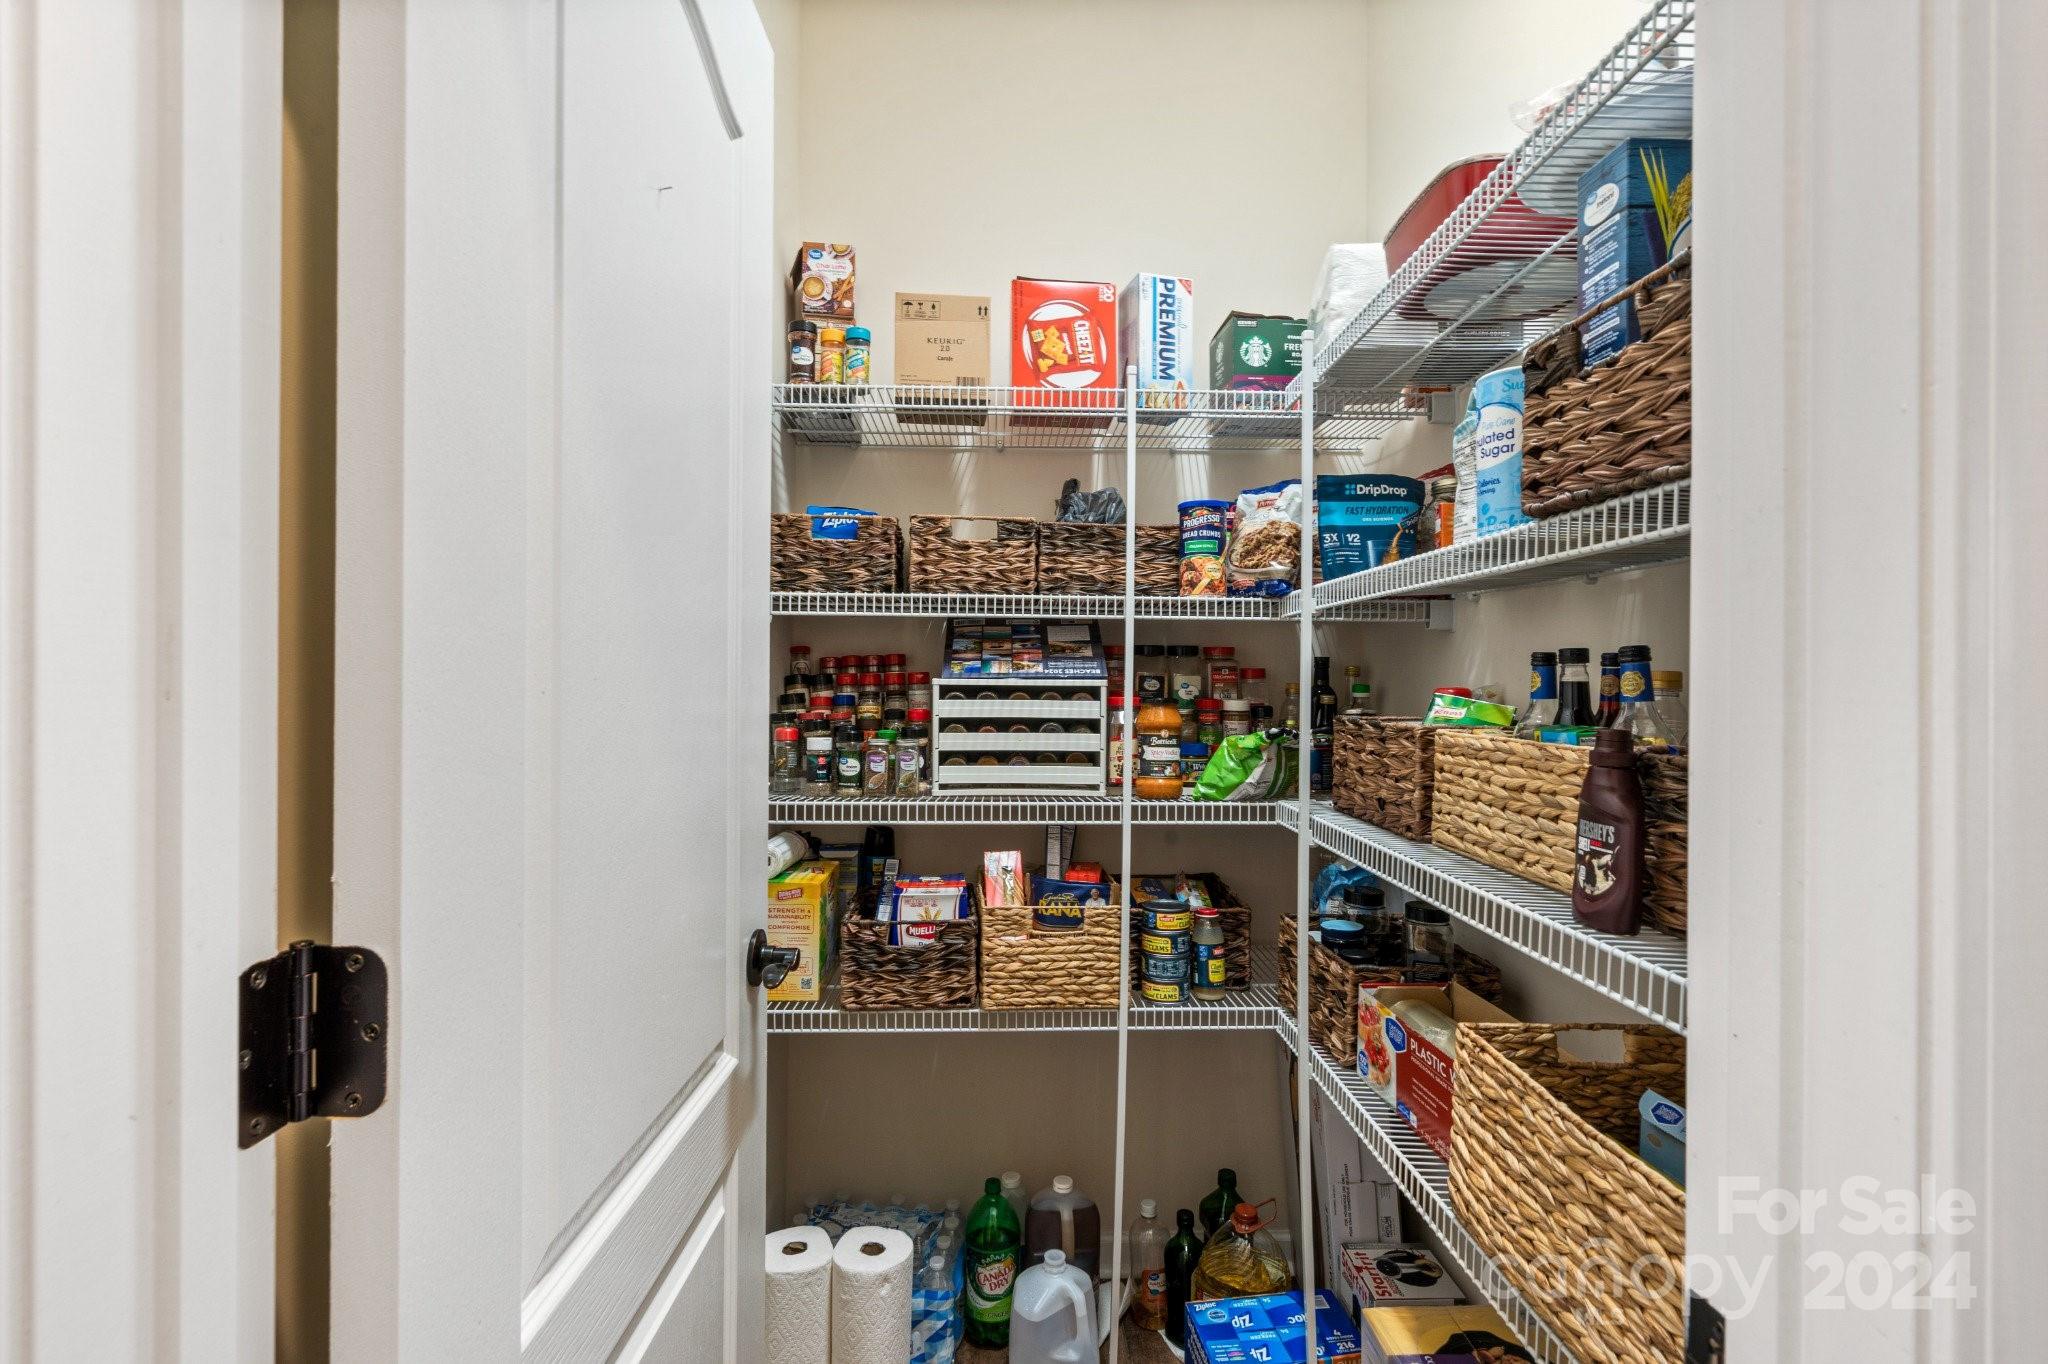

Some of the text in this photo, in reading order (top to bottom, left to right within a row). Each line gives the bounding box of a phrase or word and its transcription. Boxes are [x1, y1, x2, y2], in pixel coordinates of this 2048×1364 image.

[1158, 277, 1176, 381] PREMIUM
[926, 337, 965, 345] KEURIG
[1480, 443, 1516, 459] Sugar
[1356, 484, 1408, 497] DripDrop
[1345, 505, 1409, 515] FAST HYDRATION
[1183, 514, 1221, 528] PROGRESSO
[1182, 529, 1221, 540] BREAD CRUMBS
[1323, 533, 1338, 543] 3X
[909, 926, 936, 936] MUELL
[1410, 1038, 1447, 1078] PLASTIC
[977, 1263, 1014, 1286] CANADA
[1354, 1251, 1393, 1298] Starfrit
[989, 1277, 1009, 1291] DRY
[1194, 1301, 1218, 1311] Ziploc
[1337, 1341, 1355, 1350] 216
